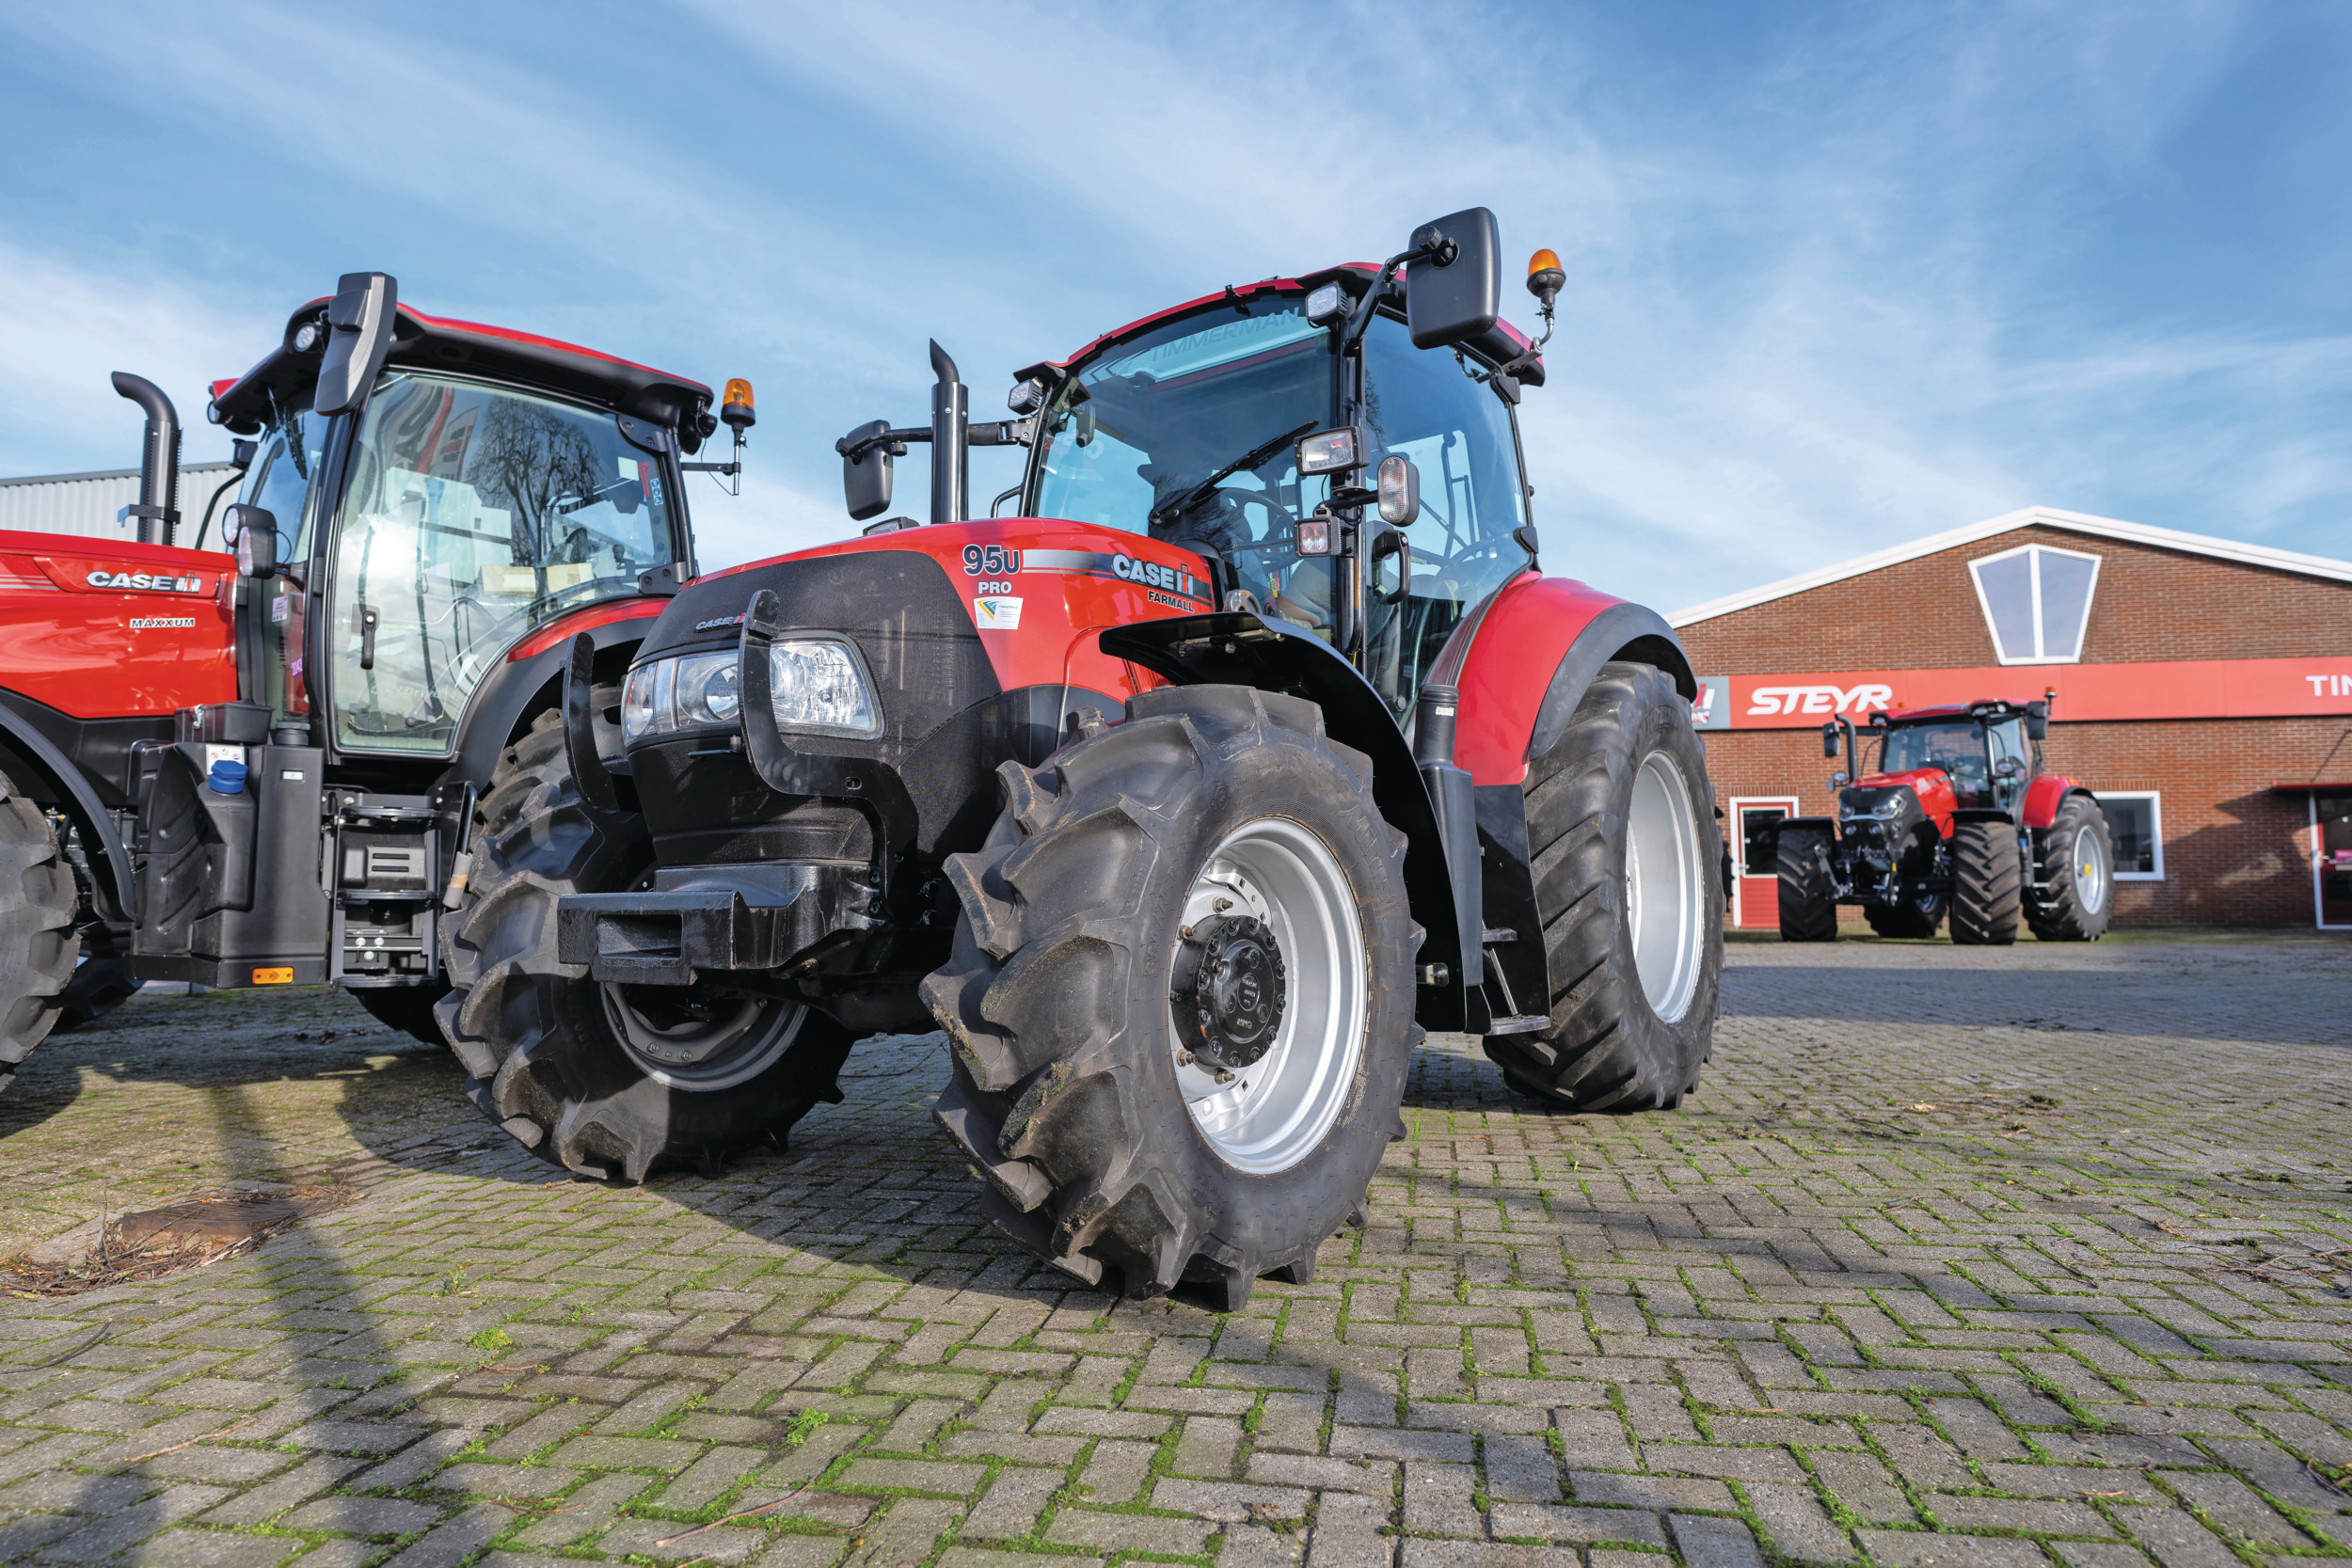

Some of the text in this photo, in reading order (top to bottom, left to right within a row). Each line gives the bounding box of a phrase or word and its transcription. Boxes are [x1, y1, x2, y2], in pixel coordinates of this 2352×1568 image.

[1152, 307, 1300, 362] TIMMERMAN
[962, 544, 1021, 577] 95U
[86, 570, 173, 591] CASE
[1113, 554, 1175, 591] CASE
[977, 581, 1013, 594] PRO
[1148, 590, 1195, 612] FARMALL
[130, 618, 196, 628] MAXXUM
[695, 616, 734, 630] CASE
[1746, 684, 1894, 715] STEYR
